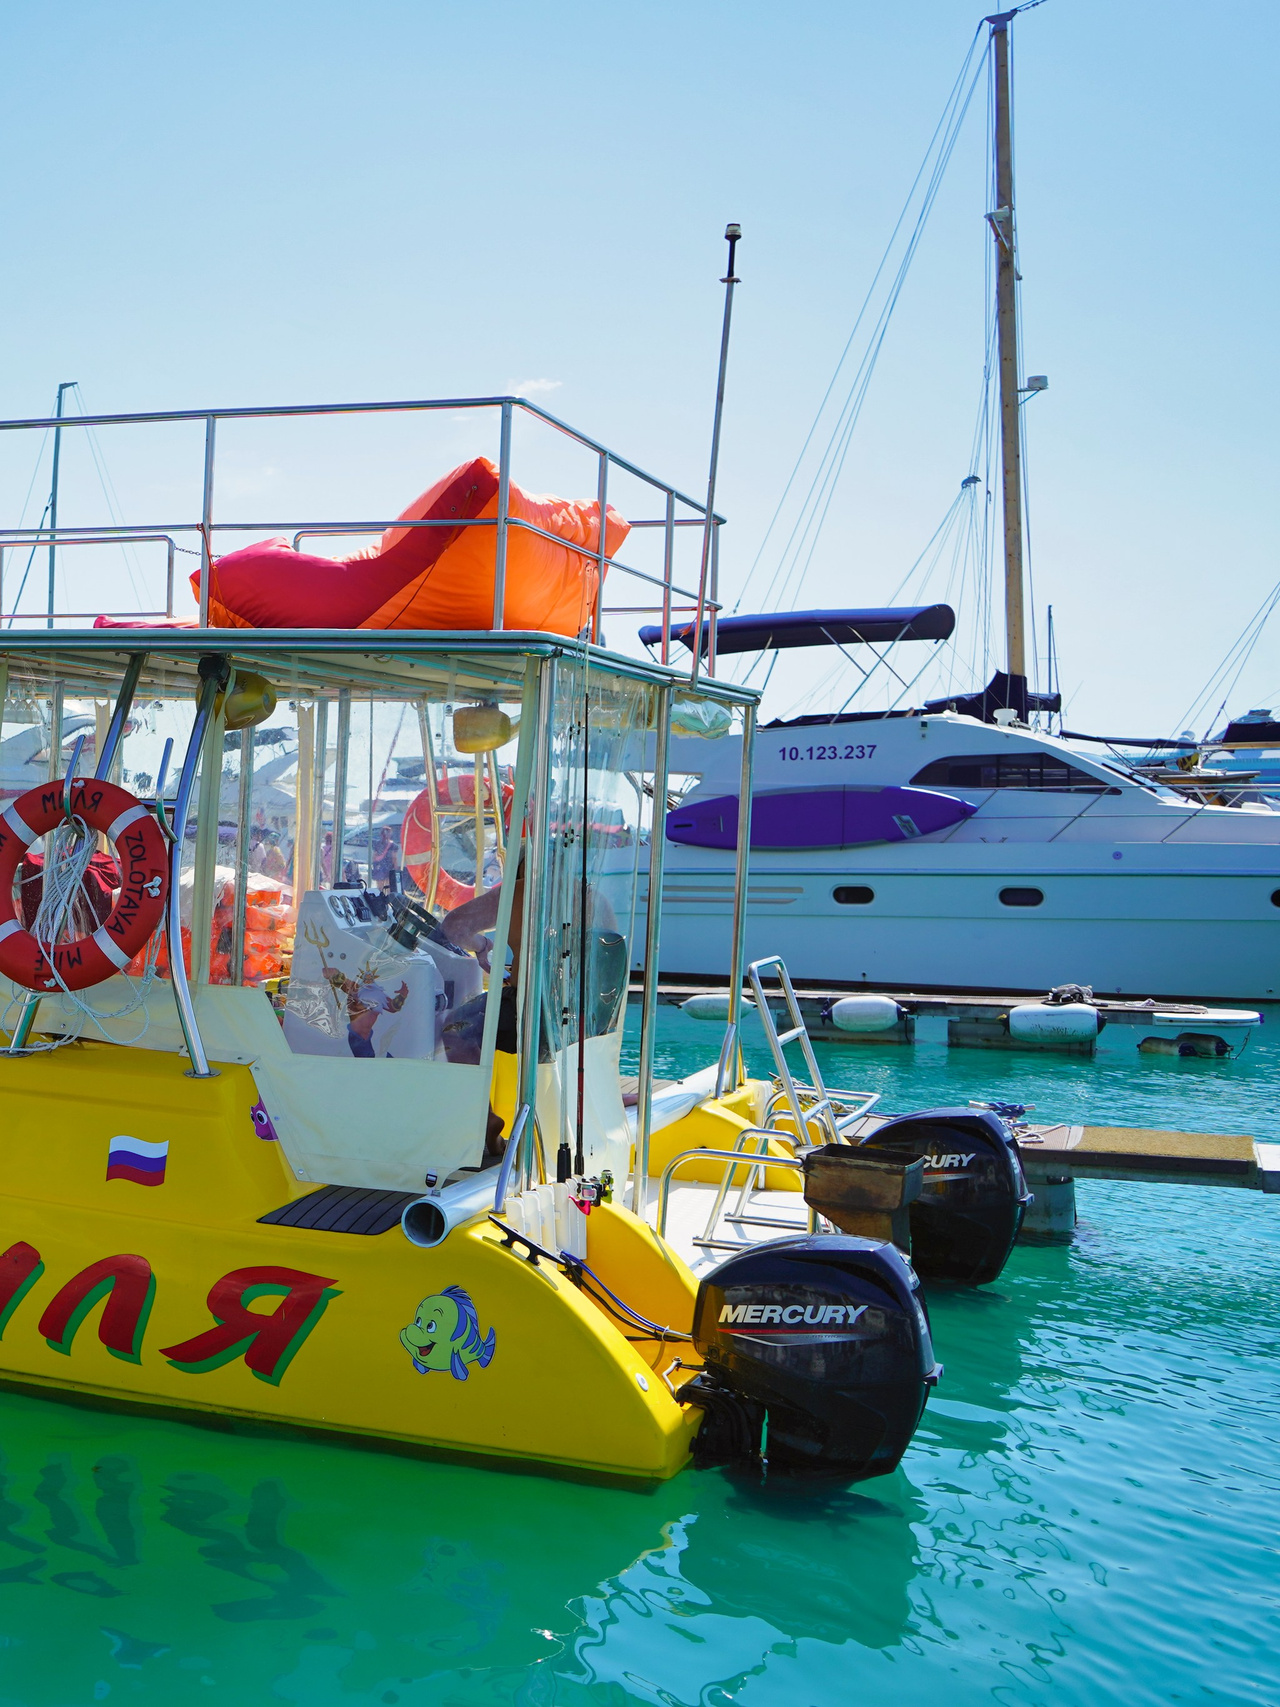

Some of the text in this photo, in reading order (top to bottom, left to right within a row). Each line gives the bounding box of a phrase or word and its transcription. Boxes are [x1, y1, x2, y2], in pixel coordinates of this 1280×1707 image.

[779, 744, 877, 761] 10.123.237
[107, 830, 147, 936] ZOLOTAYA
[923, 1153, 977, 1168] CURY
[718, 1304, 869, 1324] MERCURY
